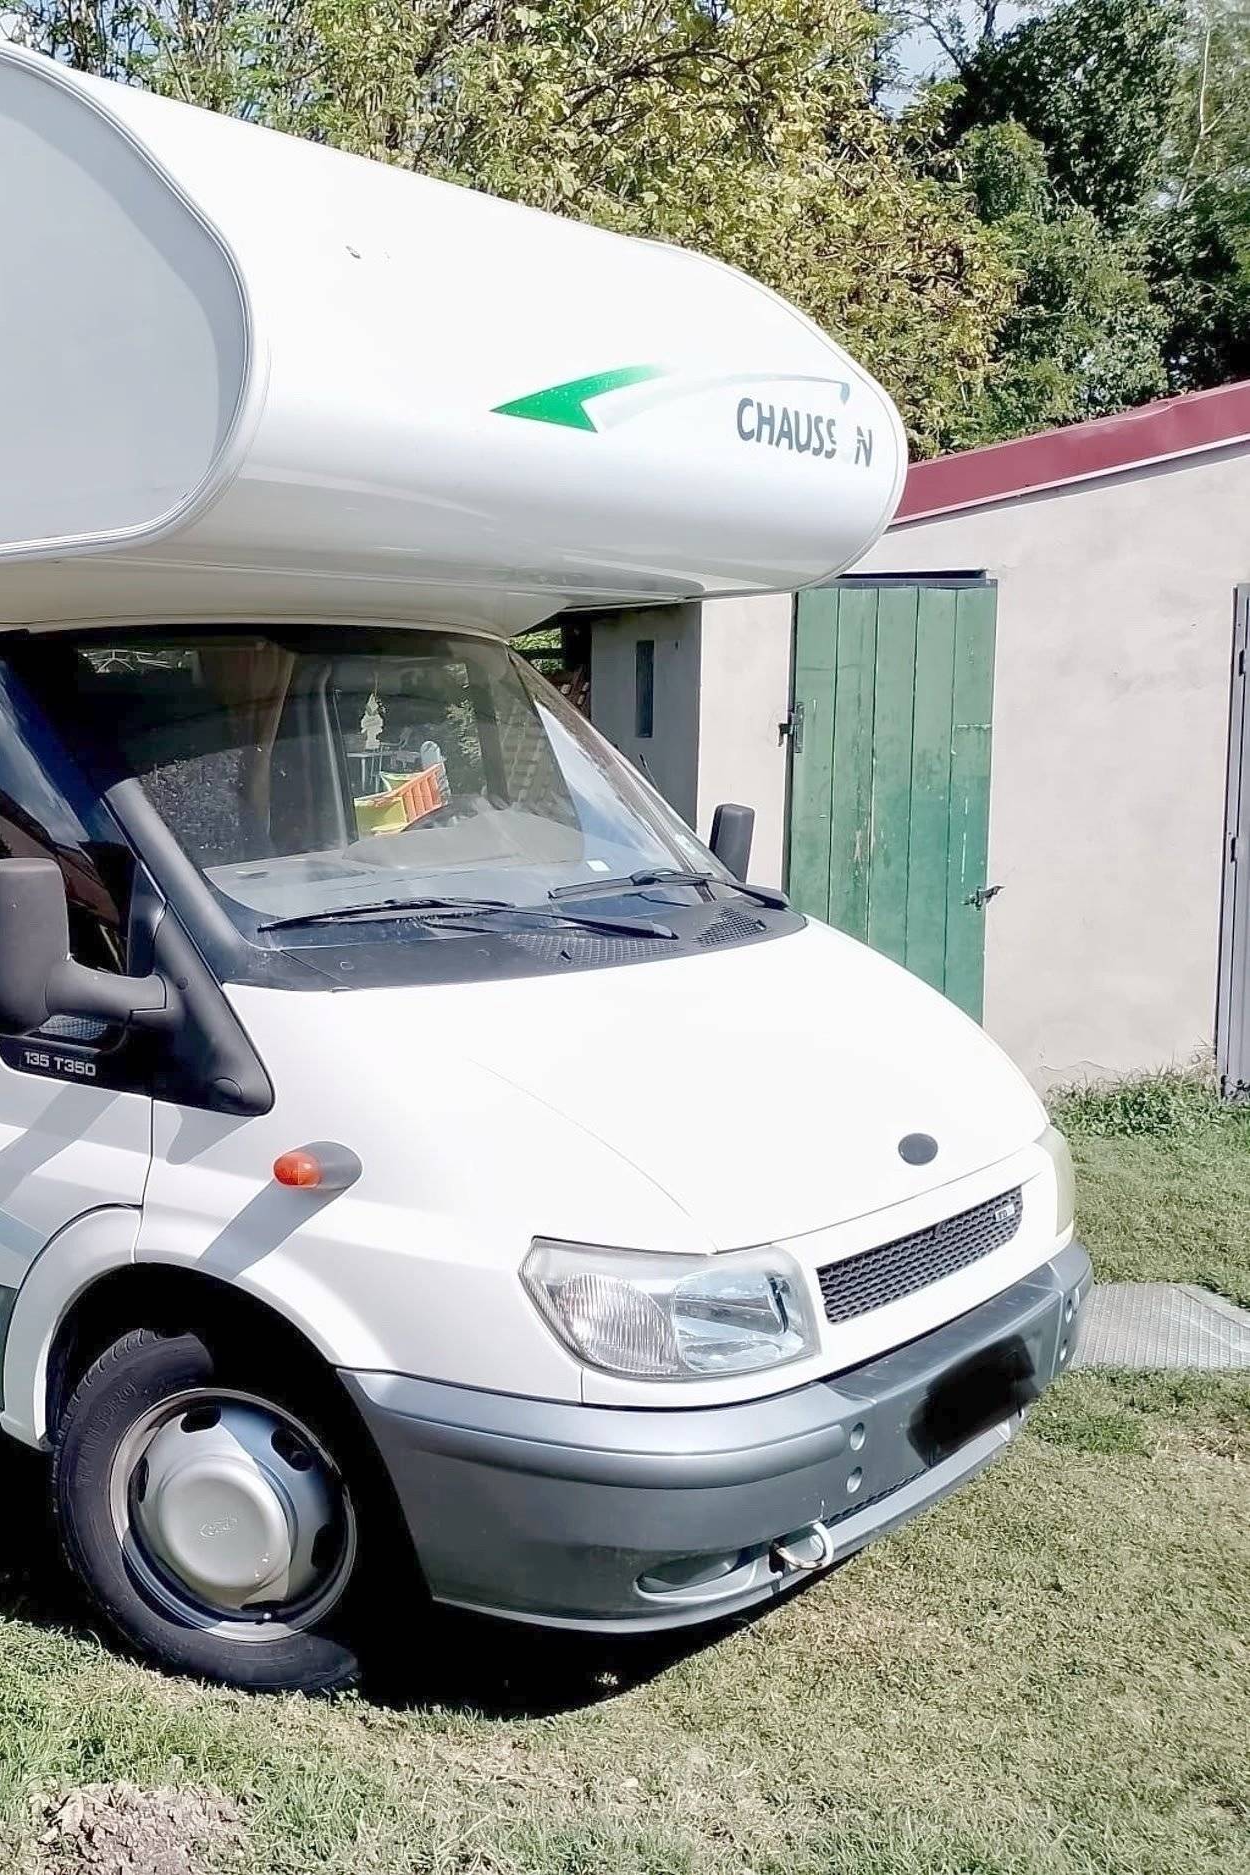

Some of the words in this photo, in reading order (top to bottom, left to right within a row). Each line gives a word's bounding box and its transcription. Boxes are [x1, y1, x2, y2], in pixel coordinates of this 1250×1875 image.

[737, 397, 872, 467] CHAUSSN
[24, 1051, 50, 1068] 135
[53, 1056, 96, 1077] T350
